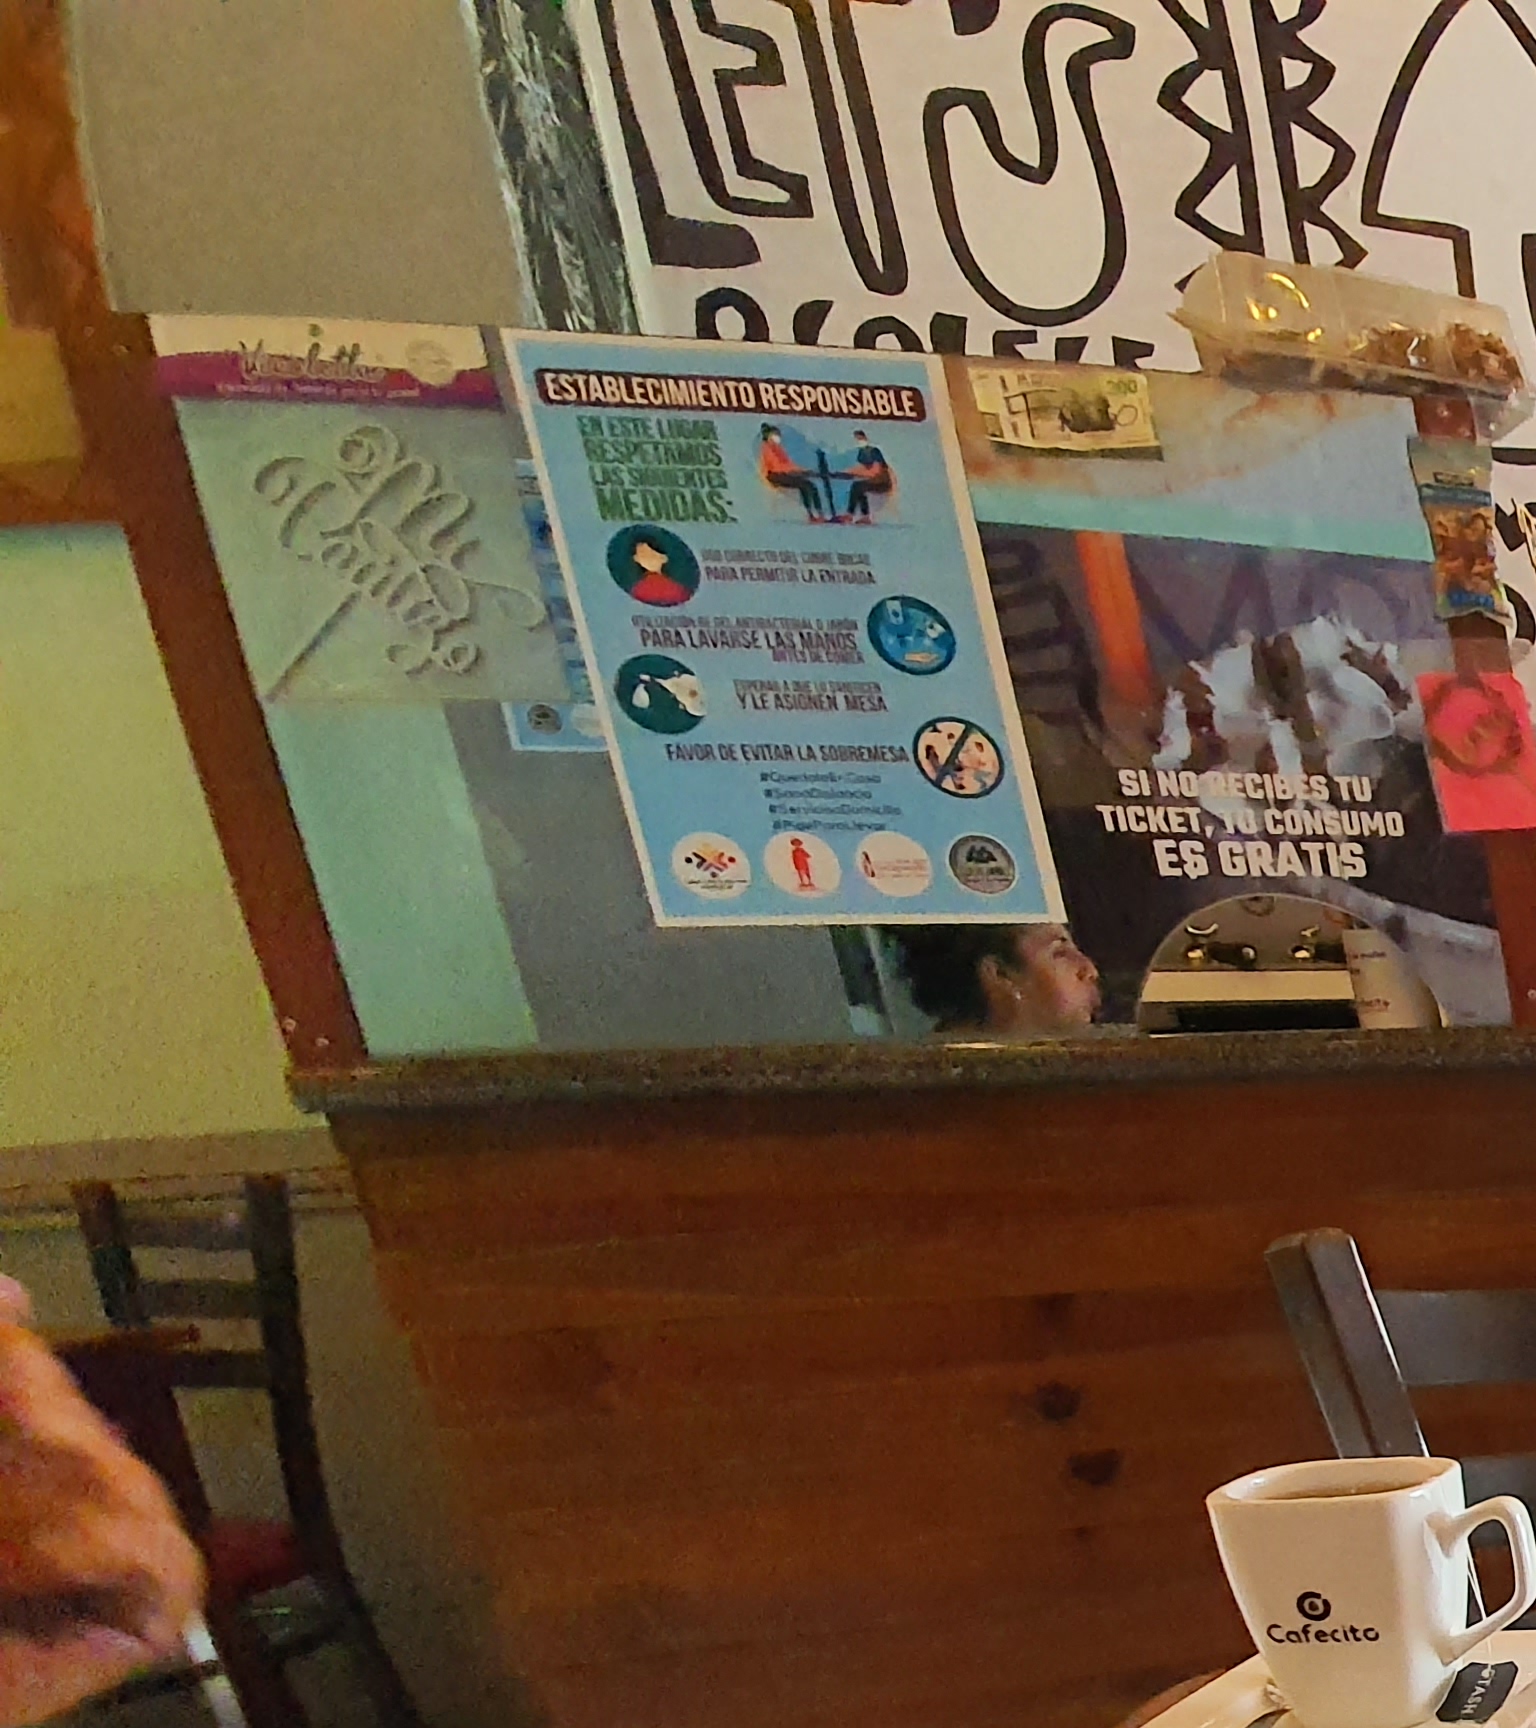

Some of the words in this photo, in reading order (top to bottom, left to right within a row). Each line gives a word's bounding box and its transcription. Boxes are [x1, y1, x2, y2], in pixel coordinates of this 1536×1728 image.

[543, 372, 757, 408] ESTABLECIMIENTO
[759, 381, 918, 418] RESPONSABLE
[607, 415, 652, 438] ESTE
[656, 418, 719, 442] LUGAR
[583, 437, 723, 467] RESPETAMOS
[588, 464, 625, 487] LAS
[597, 488, 738, 523] MEDIDAS:
[704, 567, 739, 582] PARA
[801, 568, 818, 583] LA
[819, 569, 876, 585] ENTRADA
[639, 628, 686, 648] PARA
[689, 629, 762, 650] LAVARSE
[765, 631, 796, 650] LAS
[799, 631, 858, 652] MANOS
[736, 693, 749, 710] Y
[751, 693, 770, 710] LE
[773, 693, 839, 712] ASIGNEN
[844, 694, 889, 713] MESA
[665, 742, 717, 762] FAVOR
[720, 743, 738, 762] DE
[740, 743, 794, 763] EVITAR
[797, 744, 817, 763] LA
[819, 744, 910, 764] SOBREMESA
[1118, 768, 1151, 798] SI
[1156, 769, 1198, 799] NO
[1201, 770, 1330, 802] RECIBES
[1332, 773, 1373, 803] TU
[1095, 804, 1215, 839] TICKET,
[1221, 807, 1258, 835] TU
[1263, 807, 1406, 838] CONSUMO
[1265, 1622, 1381, 1646] Cafecito
